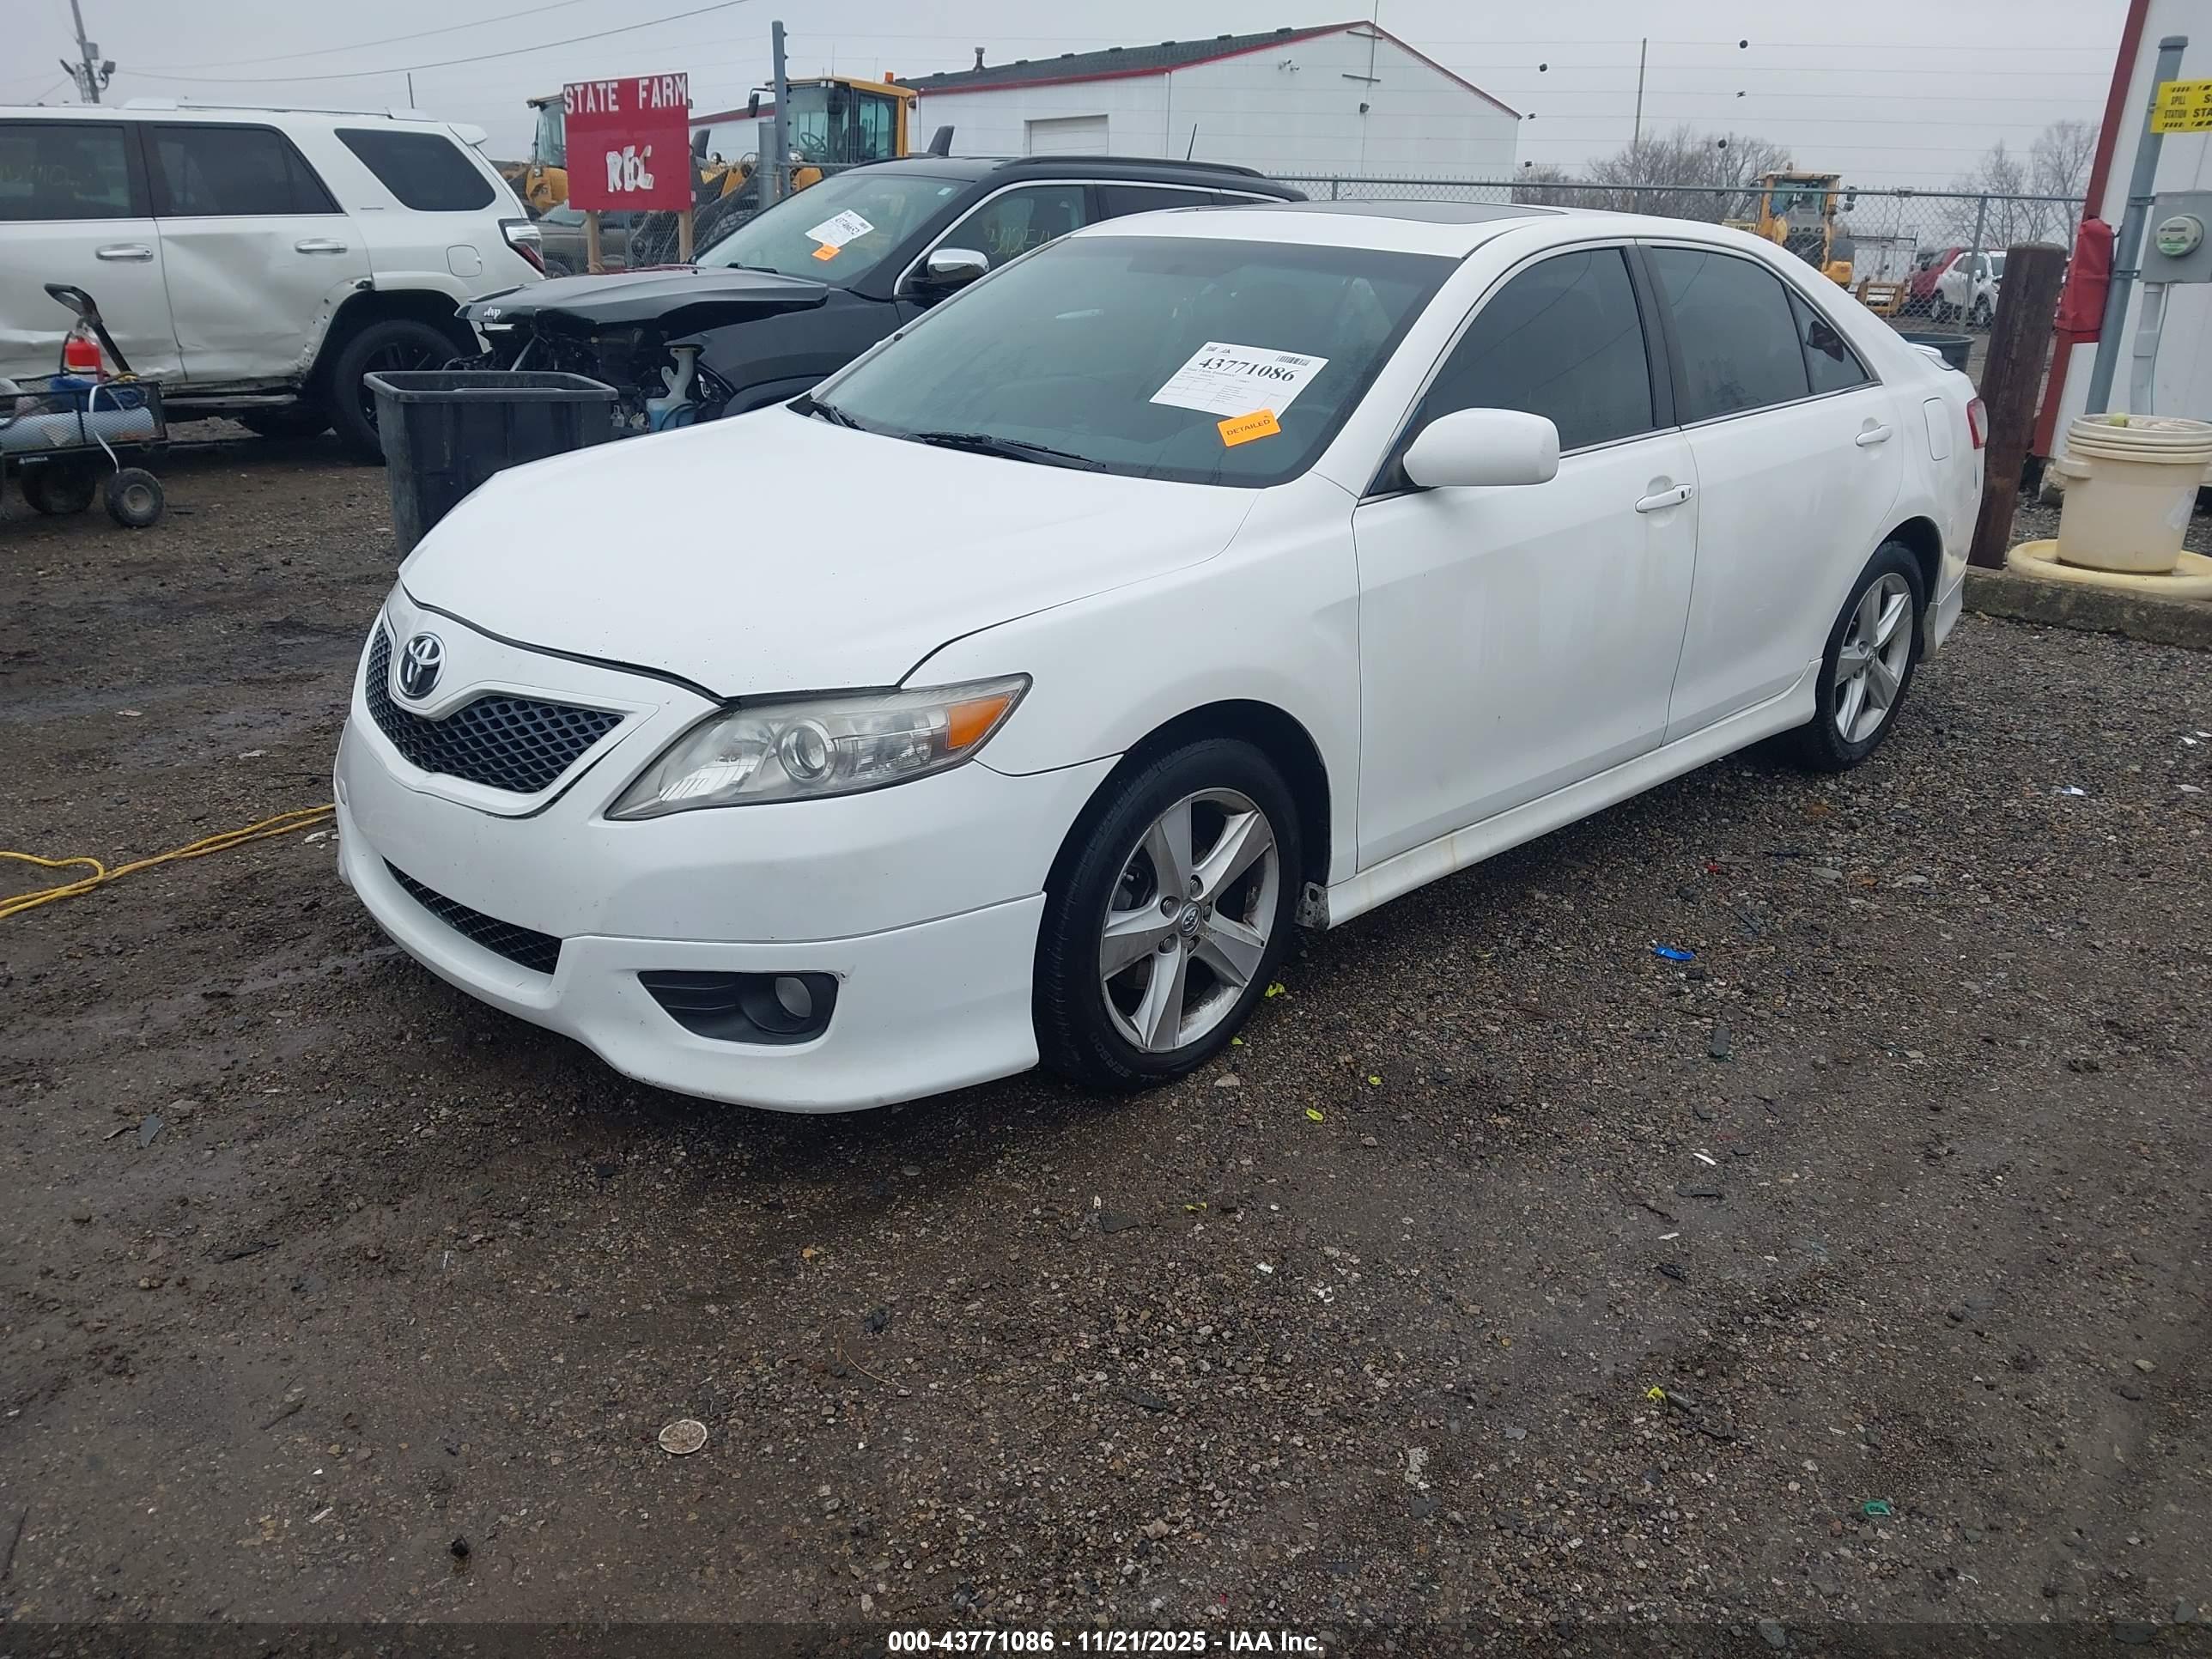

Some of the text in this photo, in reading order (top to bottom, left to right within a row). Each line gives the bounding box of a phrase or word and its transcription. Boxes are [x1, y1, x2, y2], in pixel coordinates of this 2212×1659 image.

[564, 75, 688, 115] STATE FARM
[2171, 96, 2185, 106] SPILL
[2164, 110, 2187, 118] STATION
[1199, 357, 1299, 382] 43771086
[1226, 418, 1271, 436] DETAILED
